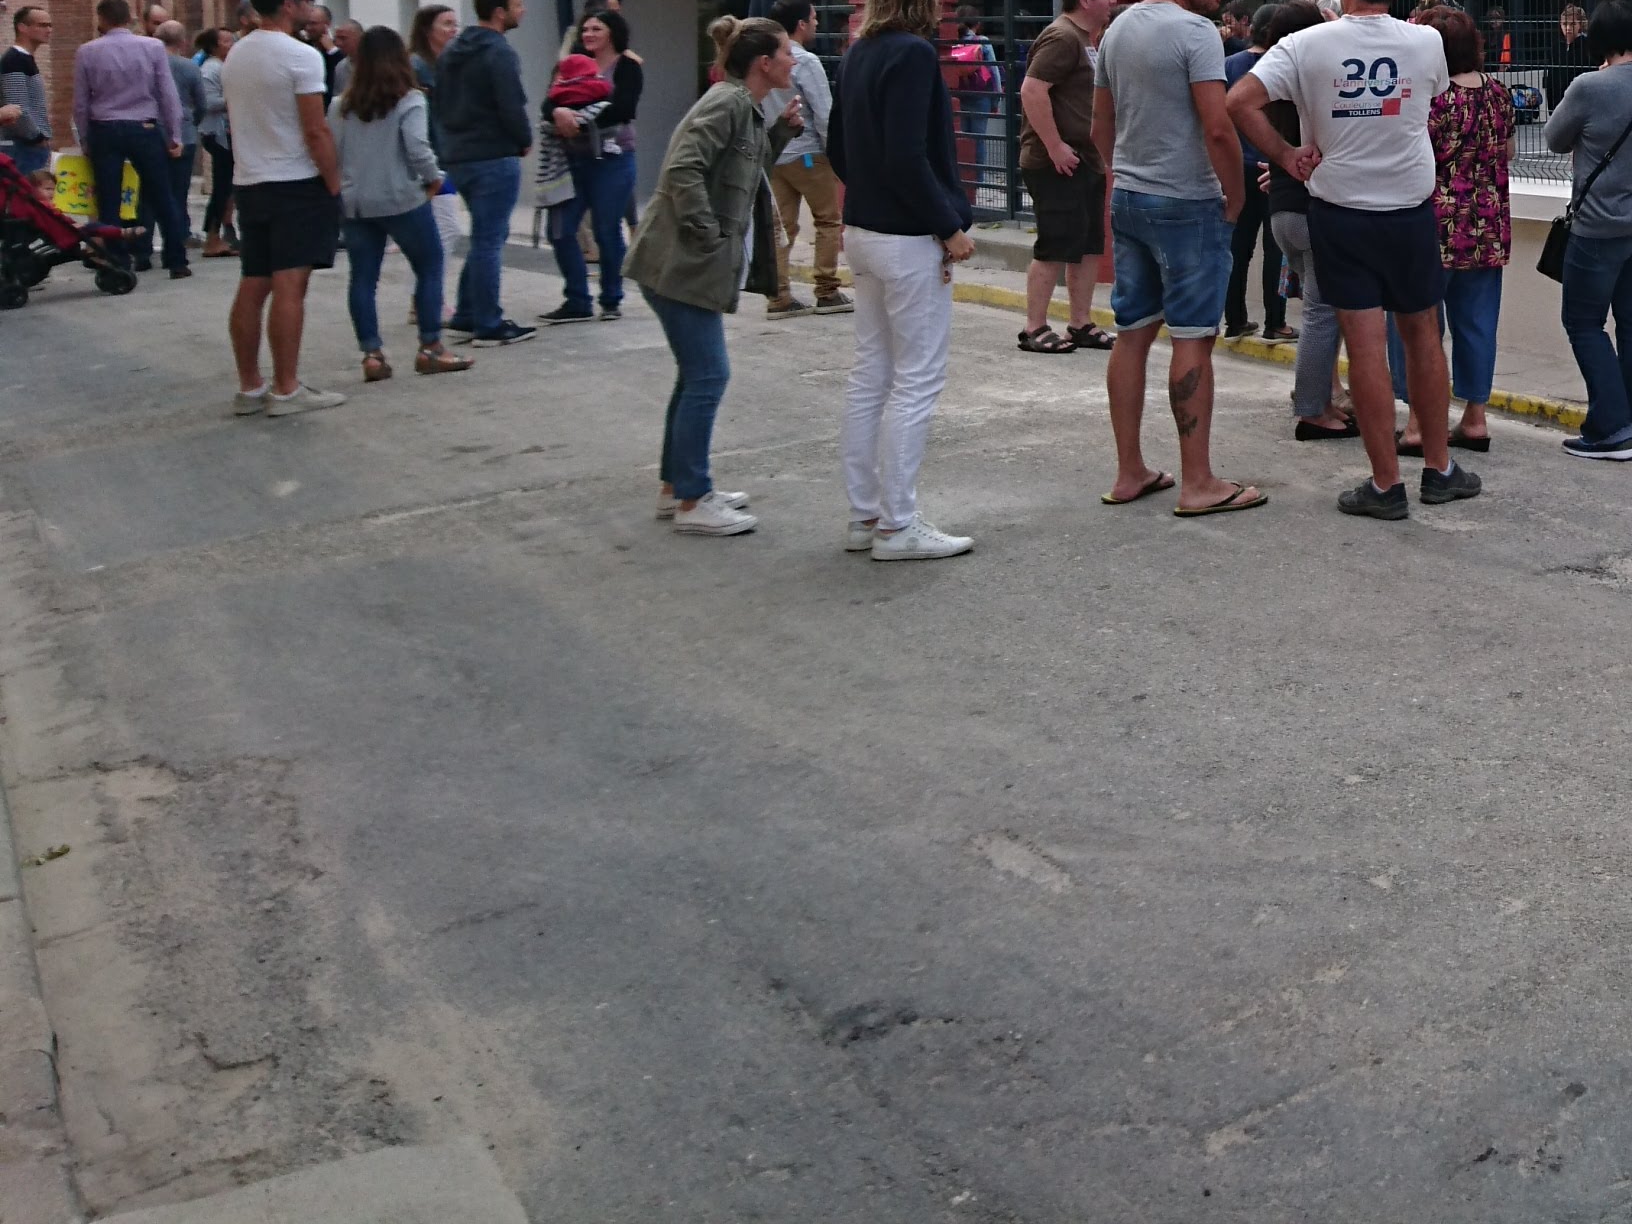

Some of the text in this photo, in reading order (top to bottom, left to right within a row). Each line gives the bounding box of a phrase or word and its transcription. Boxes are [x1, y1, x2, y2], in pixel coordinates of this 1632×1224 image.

[1333, 77, 1412, 88] L'anniversaire
[1338, 57, 1398, 98] 30
[1334, 101, 1371, 109] Couleurs
